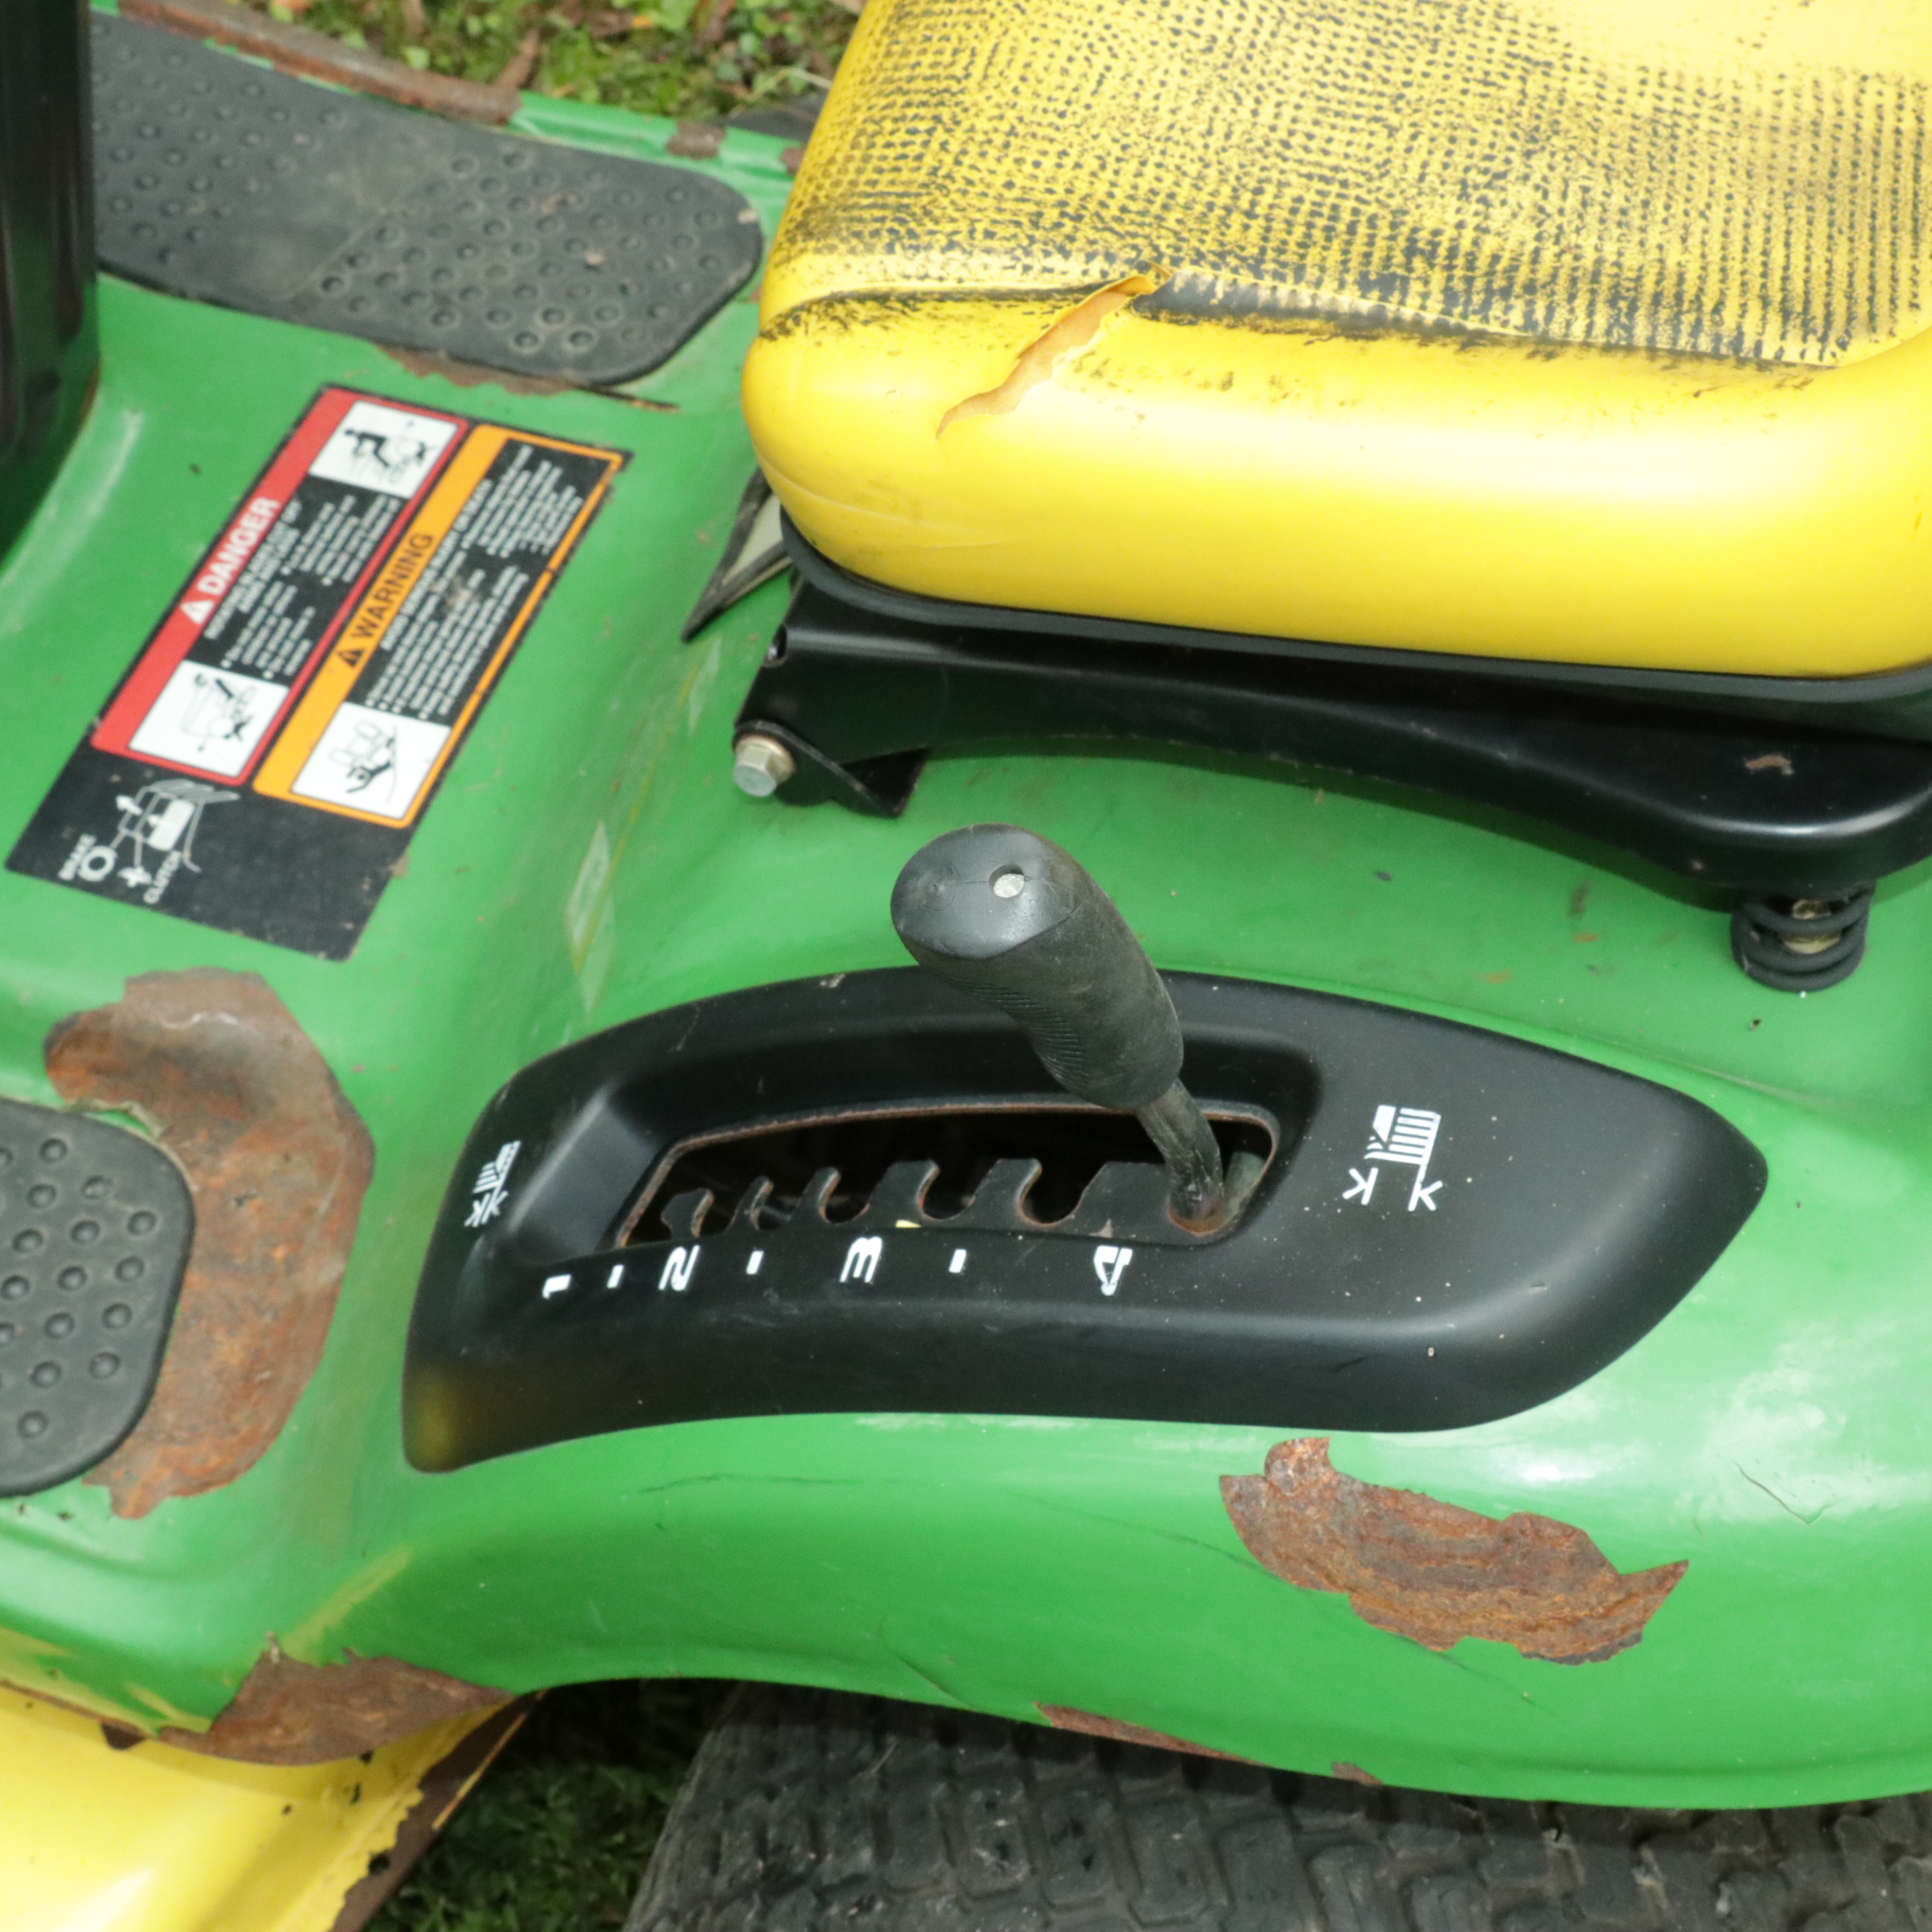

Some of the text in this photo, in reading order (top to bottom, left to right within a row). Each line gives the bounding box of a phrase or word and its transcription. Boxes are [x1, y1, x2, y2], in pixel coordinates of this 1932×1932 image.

[199, 501, 275, 595] DANGER
[356, 534, 433, 639] WARNING
[59, 834, 96, 880] BRAKE
[143, 850, 181, 903] CLUTCH
[658, 1245, 700, 1291] 2
[839, 1236, 882, 1284] 3
[1093, 1245, 1133, 1296] 4
